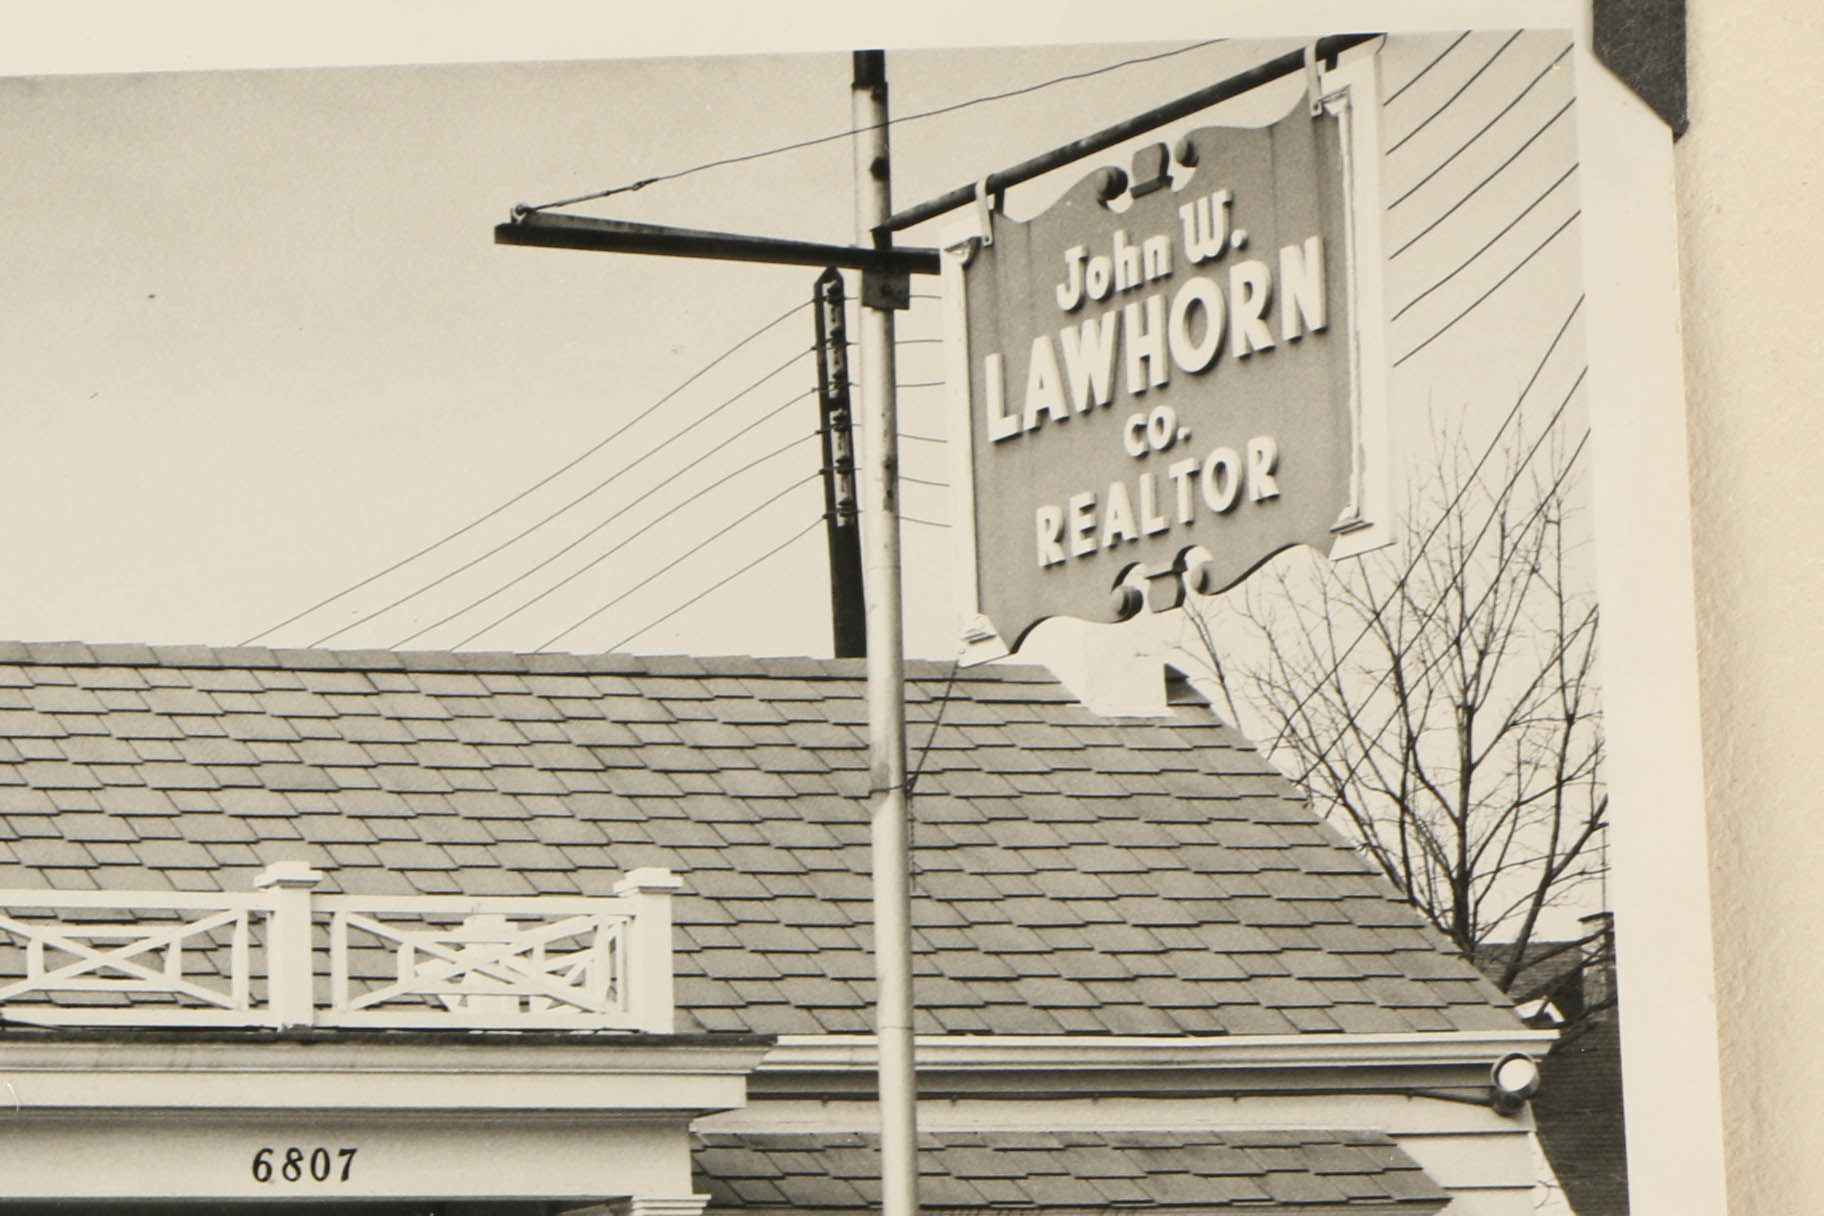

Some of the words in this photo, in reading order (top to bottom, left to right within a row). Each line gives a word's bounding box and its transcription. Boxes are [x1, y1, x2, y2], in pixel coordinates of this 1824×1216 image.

[1056, 230, 1173, 312] John
[1179, 190, 1250, 264] W.
[984, 236, 1327, 444] LAWHORN
[1036, 437, 1281, 568] REALTOR
[252, 1147, 358, 1182] 6807
